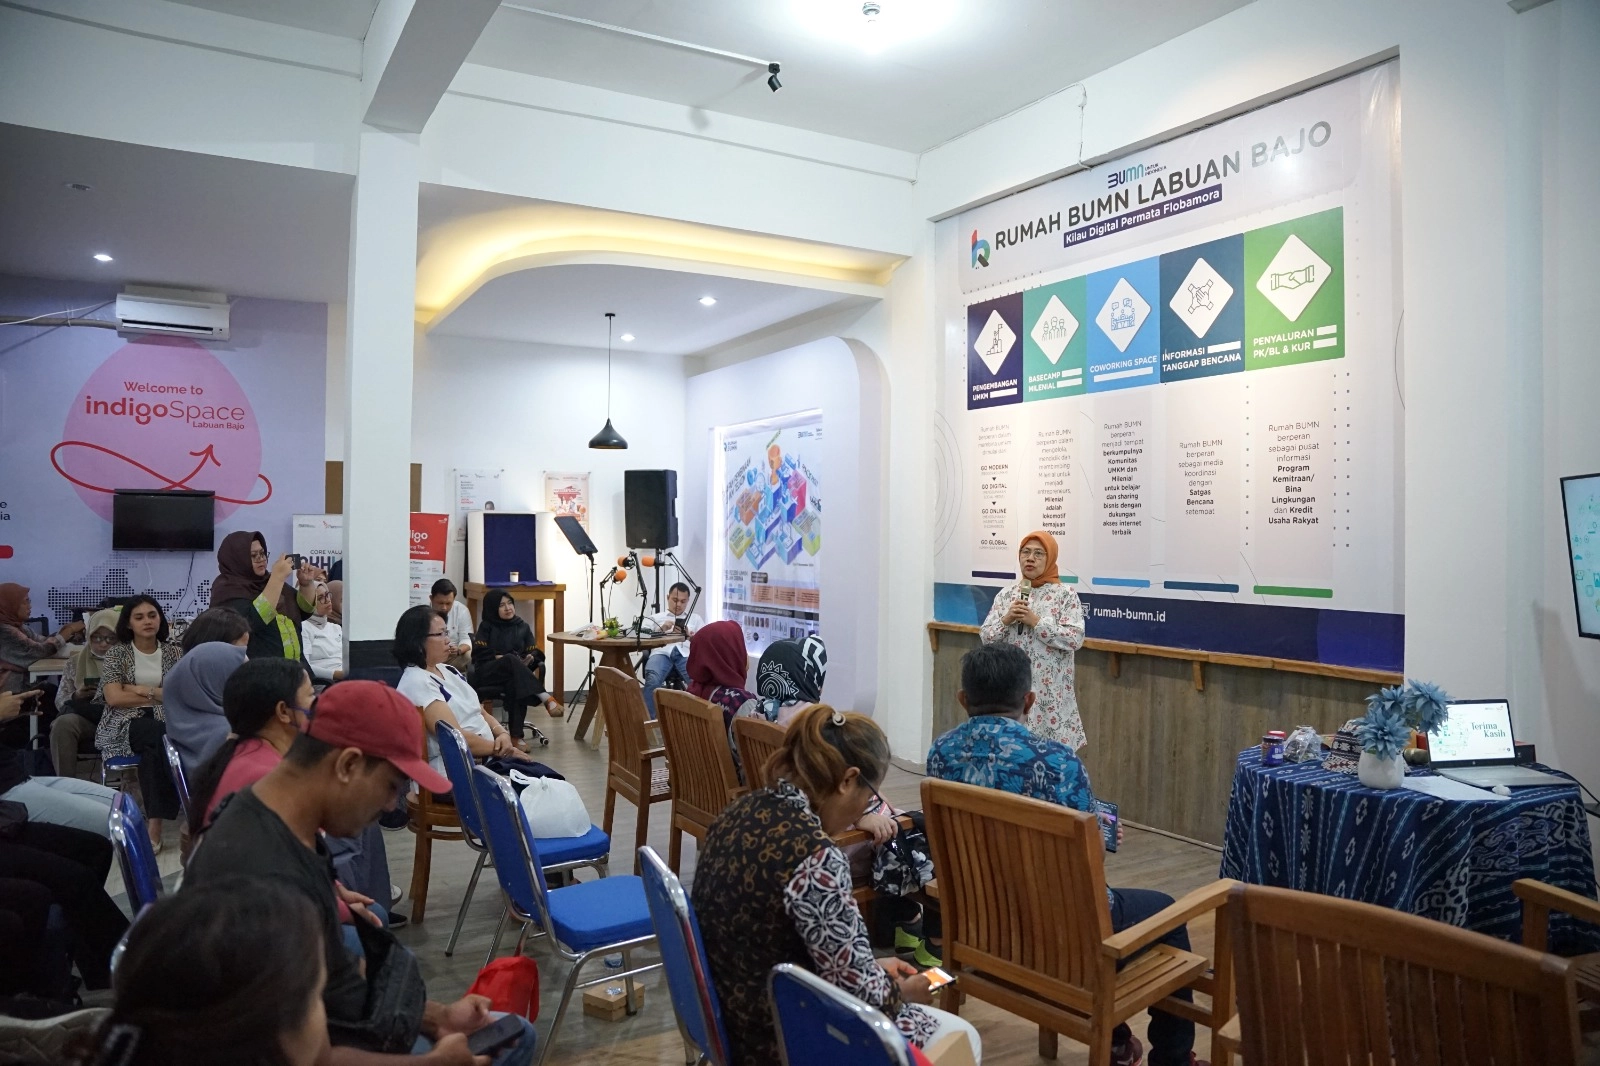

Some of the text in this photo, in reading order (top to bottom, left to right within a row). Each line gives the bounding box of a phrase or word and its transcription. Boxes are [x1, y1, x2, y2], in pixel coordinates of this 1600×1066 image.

[995, 120, 1332, 250] RUMAH BUMN LABUAN BAJO
[1066, 188, 1220, 244] Kilau Digital Permata Flobamora
[1253, 328, 1315, 346] PENYALURAN
[1253, 341, 1311, 358] PK/BL & KUR
[1162, 348, 1205, 362] INFORMASI
[1089, 355, 1157, 373] COWORKING SPACE
[1162, 353, 1241, 372] TANGGAP BENCANA
[1028, 371, 1061, 383] BASECAMP
[124, 381, 203, 395] Welcome to
[972, 378, 1018, 392] PENGEMBANGAN
[1028, 382, 1056, 393] MILENIAL
[972, 392, 989, 401] UMKM
[86, 395, 245, 425] indigoSpace
[193, 421, 245, 431] Labuan Bajo
[1124, 420, 1142, 428] BUMN
[1268, 421, 1320, 432] Rumah BUMN
[1277, 433, 1311, 442] berperan
[1179, 439, 1223, 449] Rumah BUMN
[1268, 442, 1320, 453] sebagai pusat
[1103, 447, 1143, 457] berkumpulnya
[1186, 450, 1215, 459] berperan
[1107, 457, 1138, 465] Komunitas
[1276, 453, 1311, 462] informasi
[1178, 459, 1224, 469] sebagai media
[1277, 464, 1310, 473] Program
[1184, 469, 1217, 477] koordinasi
[1272, 473, 1315, 483] Kemitraan/
[1188, 479, 1213, 487] dengan
[1121, 484, 1141, 493] belajar
[1189, 489, 1211, 497] Satgas
[1285, 485, 1302, 493] Bina
[1117, 493, 1139, 501] sharing
[1271, 496, 1316, 505] Lingkungan
[1120, 502, 1142, 510] dengan
[1186, 498, 1214, 506] Bencana
[1185, 508, 1215, 516] setempat
[1273, 506, 1313, 514] dan Kredit
[1108, 511, 1136, 519] dukungan
[1292, 516, 1319, 525] Rakyat
[410, 530, 428, 543] igo
[1093, 607, 1166, 623] rumah-bumn.id
[1471, 722, 1498, 731] Terima
[1484, 729, 1506, 738] Kasih
